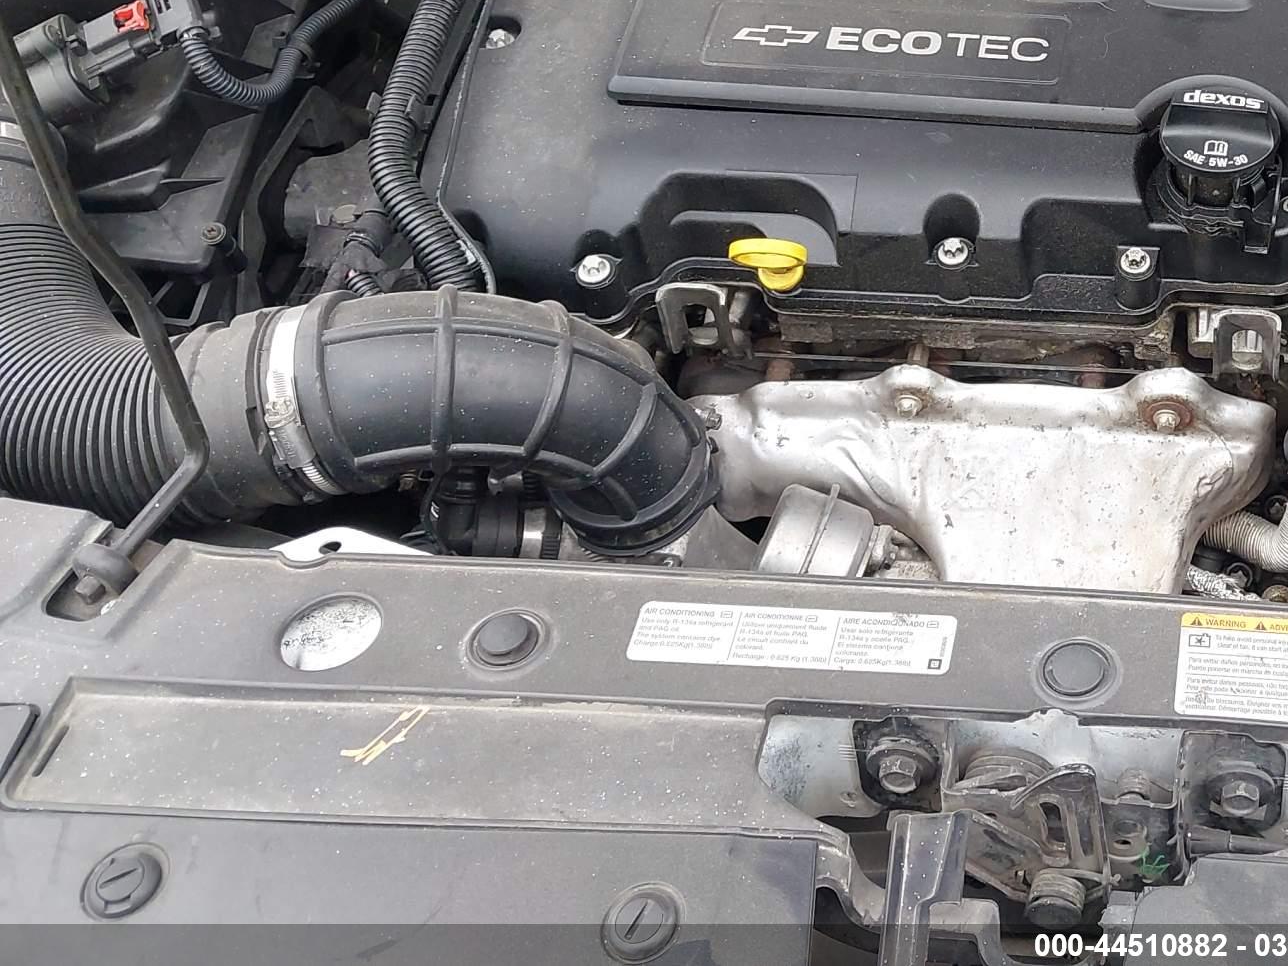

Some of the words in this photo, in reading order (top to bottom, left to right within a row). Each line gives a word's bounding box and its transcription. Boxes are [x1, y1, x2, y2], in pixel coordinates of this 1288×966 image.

[826, 27, 1049, 63] ECOTEC
[1183, 90, 1264, 109] dexos
[1184, 150, 1206, 164] SAE
[1209, 154, 1248, 167] 5W-30
[658, 608, 715, 617] CONDITIONING
[861, 617, 924, 627] ACONDICIONADO
[1205, 618, 1247, 629] WARNING
